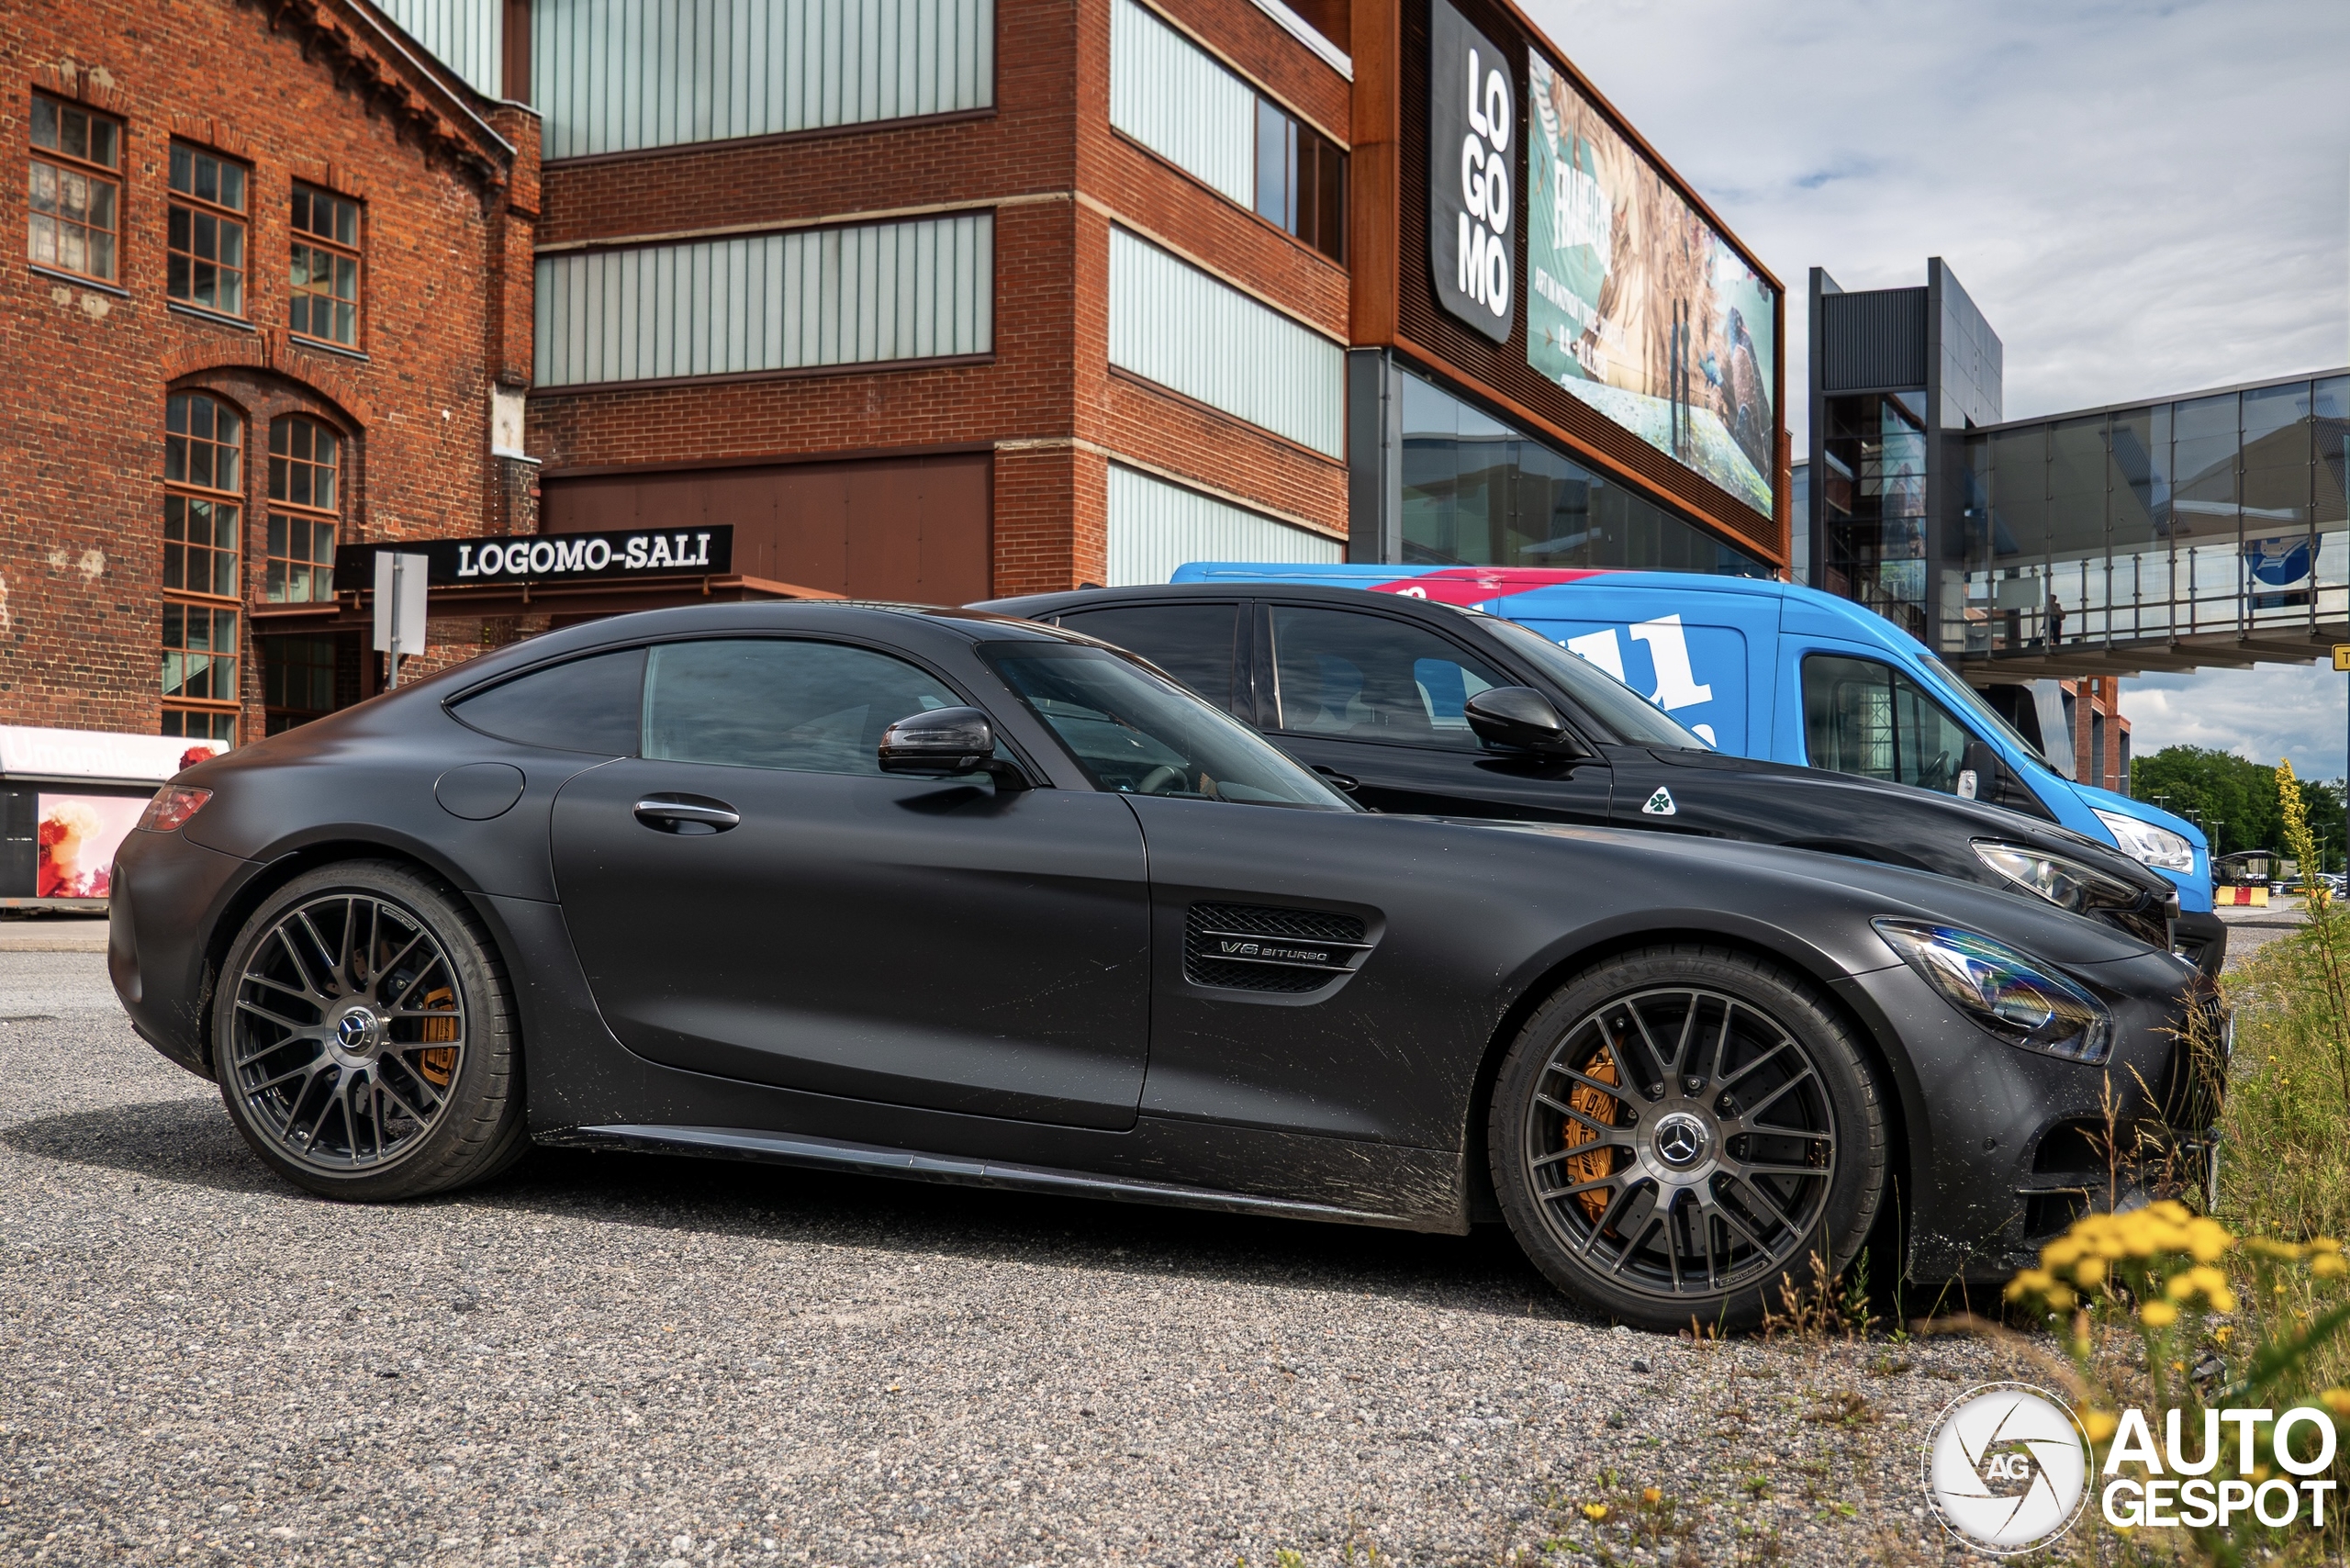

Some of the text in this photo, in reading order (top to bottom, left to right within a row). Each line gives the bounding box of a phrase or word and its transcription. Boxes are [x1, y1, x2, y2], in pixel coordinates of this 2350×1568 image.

[1469, 48, 1510, 152] LO
[1461, 133, 1510, 235] GO
[1458, 211, 1510, 318] MO
[458, 533, 711, 577] LOGOMO-SALI
[1220, 941, 1327, 961] V8 BITURBO
